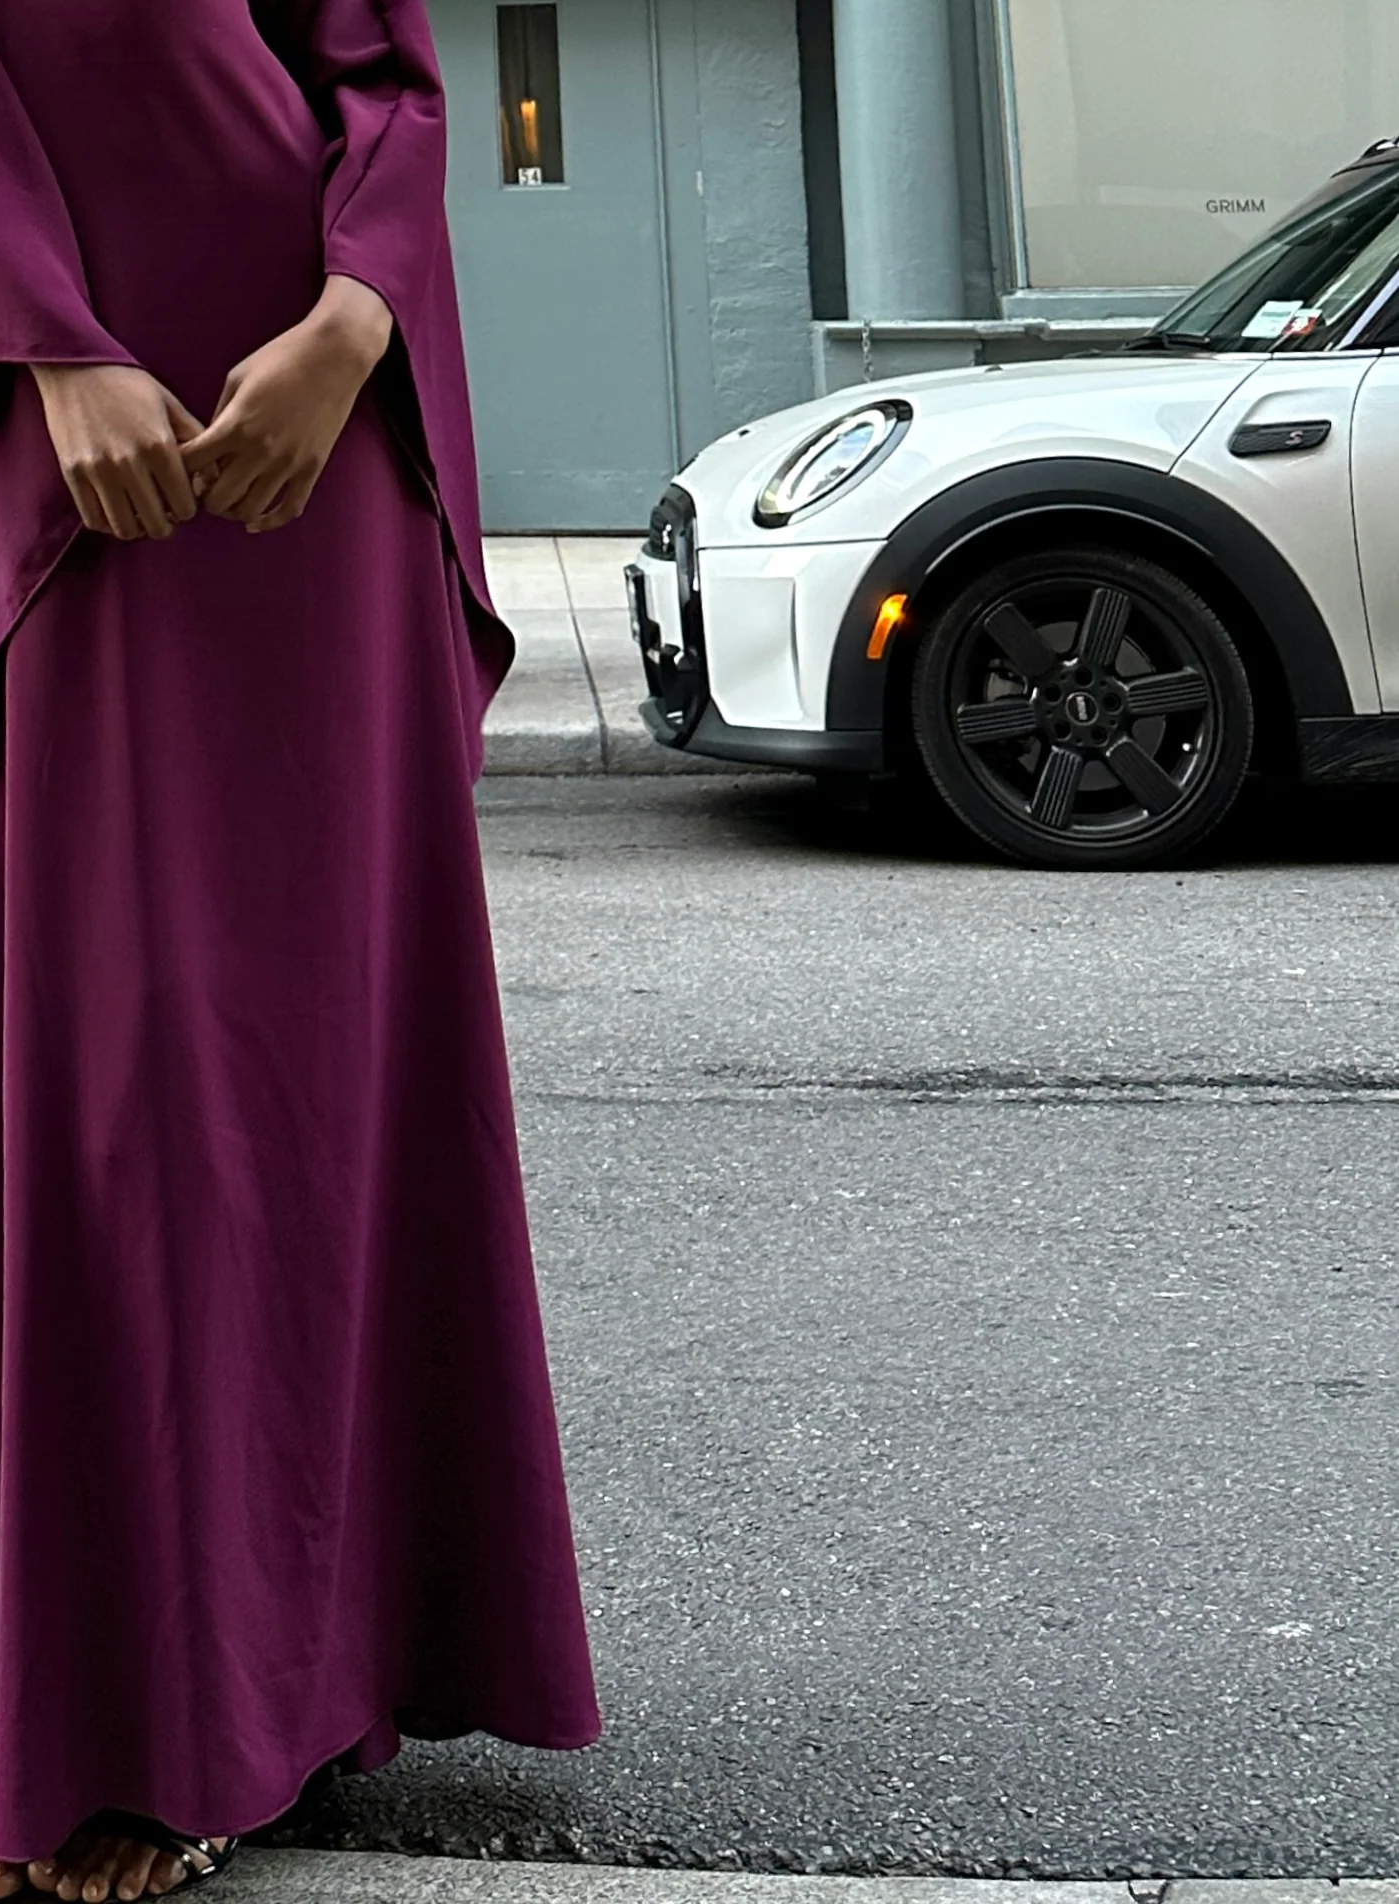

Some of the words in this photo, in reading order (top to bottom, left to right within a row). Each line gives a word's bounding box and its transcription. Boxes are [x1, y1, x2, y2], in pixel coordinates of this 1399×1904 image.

[521, 167, 539, 185] 54
[1205, 198, 1266, 214] GRIMM
[1285, 430, 1303, 445] S
